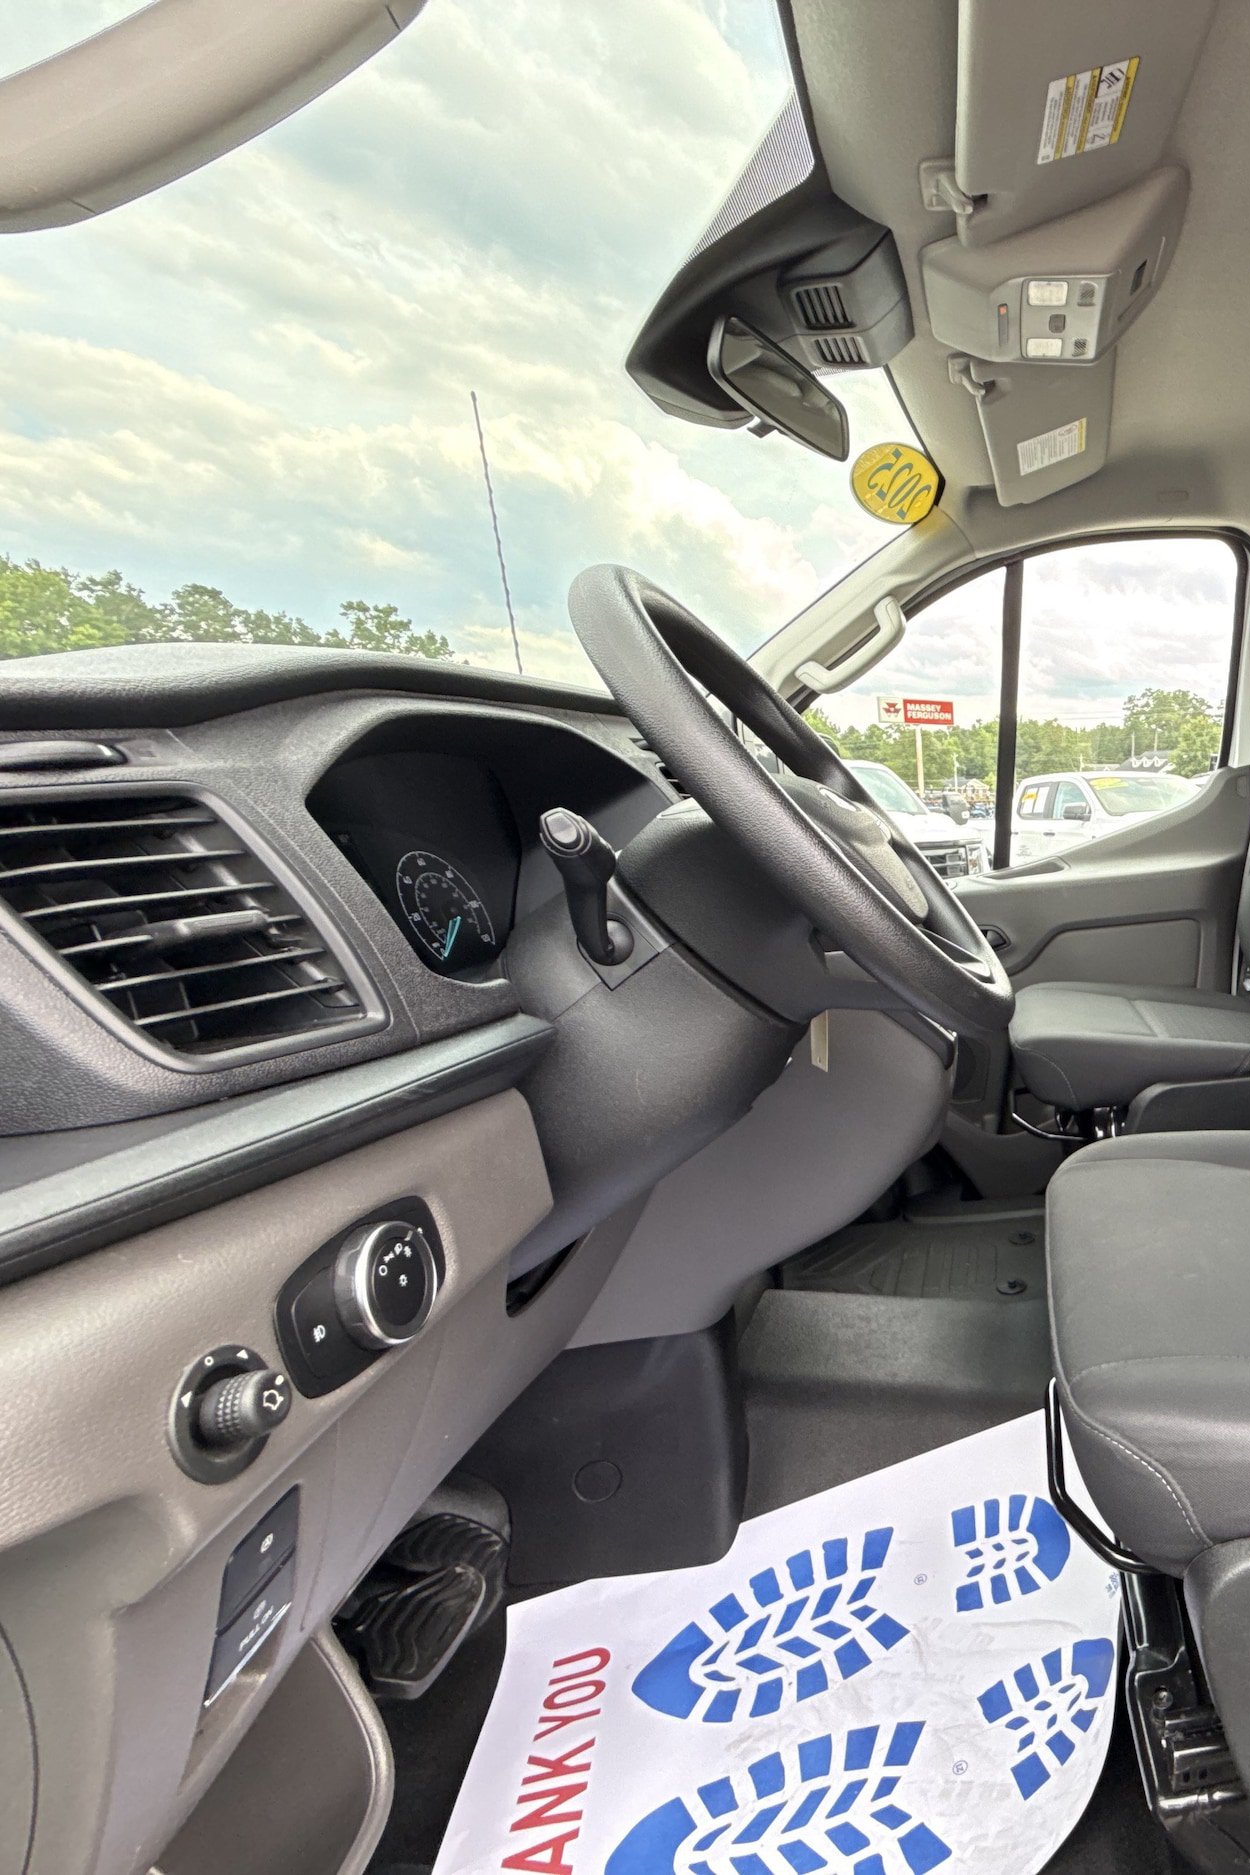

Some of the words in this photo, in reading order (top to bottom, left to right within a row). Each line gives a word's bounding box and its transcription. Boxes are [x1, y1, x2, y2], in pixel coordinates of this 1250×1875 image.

[906, 702, 942, 712] MASSEY
[906, 711, 952, 720] FERGUSON
[533, 1647, 611, 1742] YOU
